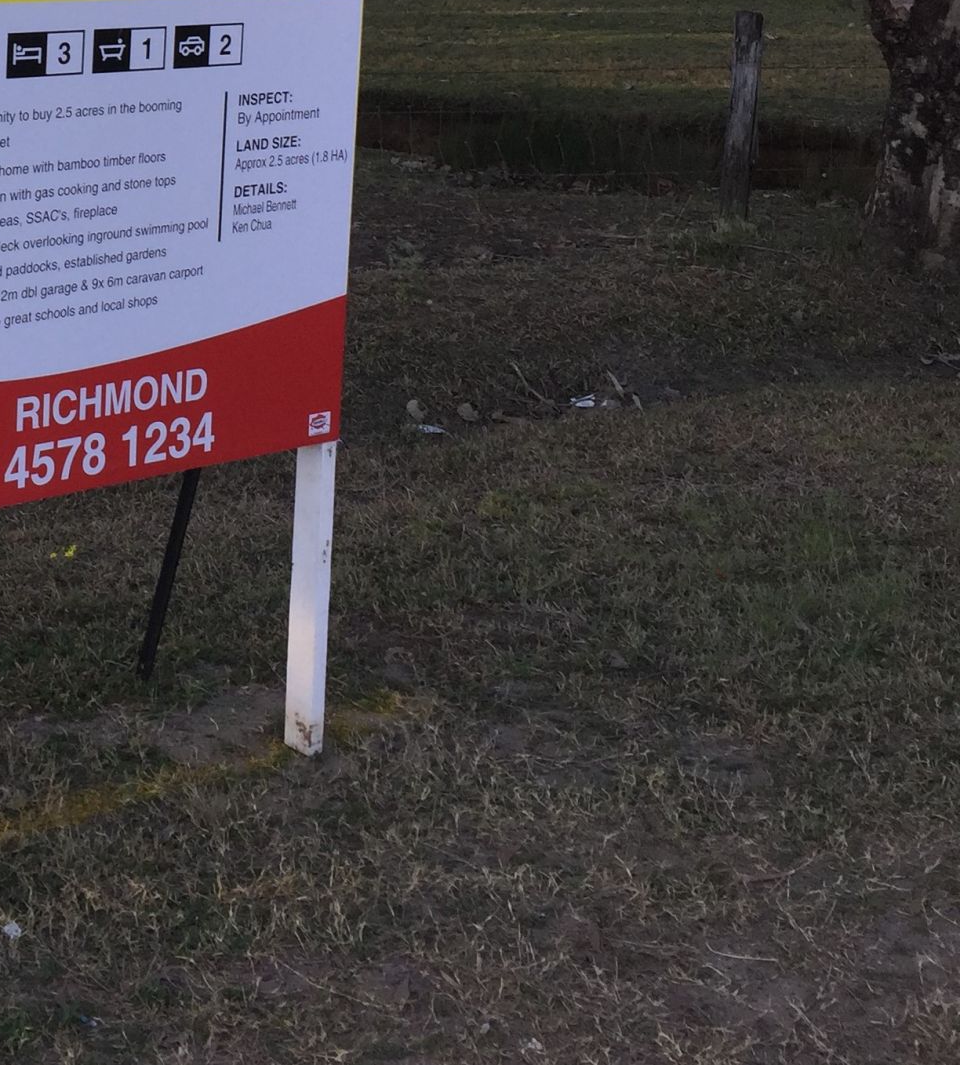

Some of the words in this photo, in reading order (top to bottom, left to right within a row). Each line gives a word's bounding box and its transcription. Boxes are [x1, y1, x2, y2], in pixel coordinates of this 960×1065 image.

[58, 42, 72, 66] 3
[142, 37, 152, 60] 1
[219, 34, 232, 56] 2
[238, 91, 293, 107] INSPECT:
[18, 111, 29, 121] to
[32, 109, 52, 122] buy
[55, 107, 72, 118] 2.5
[74, 107, 104, 117] acres
[107, 104, 116, 114] in
[119, 103, 136, 114] the
[138, 100, 182, 113] booming
[237, 112, 251, 127] By
[254, 107, 320, 125] Appointment
[236, 137, 269, 152] LAND
[271, 135, 302, 149] SIZE:
[32, 161, 54, 173] with
[57, 158, 100, 171] bamboo
[102, 155, 136, 167] timber
[138, 153, 166, 163] floors
[234, 158, 267, 173] Approx
[268, 155, 283, 168] 2.5
[285, 155, 310, 166] acres
[311, 150, 328, 166] (1.8
[330, 149, 348, 163] HA)
[9, 189, 31, 200] with
[34, 188, 54, 202] gas
[57, 184, 98, 196] cooking
[101, 179, 121, 192] and
[123, 179, 152, 190] stone
[154, 176, 176, 188] tops
[233, 182, 288, 198] DETAILS:
[25, 209, 69, 224] SSAC's,
[73, 206, 117, 220] fireplace
[233, 201, 264, 216] Michael
[266, 199, 297, 213] Bennett
[22, 233, 84, 249] overlooking
[87, 227, 132, 244] inground
[134, 223, 185, 236] swimming
[187, 218, 208, 233] pool
[232, 220, 249, 234] Ken
[250, 218, 272, 231] Chua
[5, 260, 60, 279] paddocks,
[63, 251, 123, 269] established
[125, 248, 166, 264] gardens
[20, 286, 37, 299] dbl
[40, 283, 78, 299] garage
[80, 280, 88, 291] &
[91, 278, 104, 289] 9x
[106, 276, 123, 287] 6m
[125, 272, 166, 285] caravan
[168, 266, 203, 280] carport
[3, 312, 31, 329] great
[34, 306, 75, 321] schools
[77, 302, 98, 315] and
[100, 298, 125, 312] local
[127, 296, 158, 308] shops
[15, 367, 209, 432] RICHMOND
[4, 432, 107, 490] 4578
[122, 412, 216, 468] 1234
